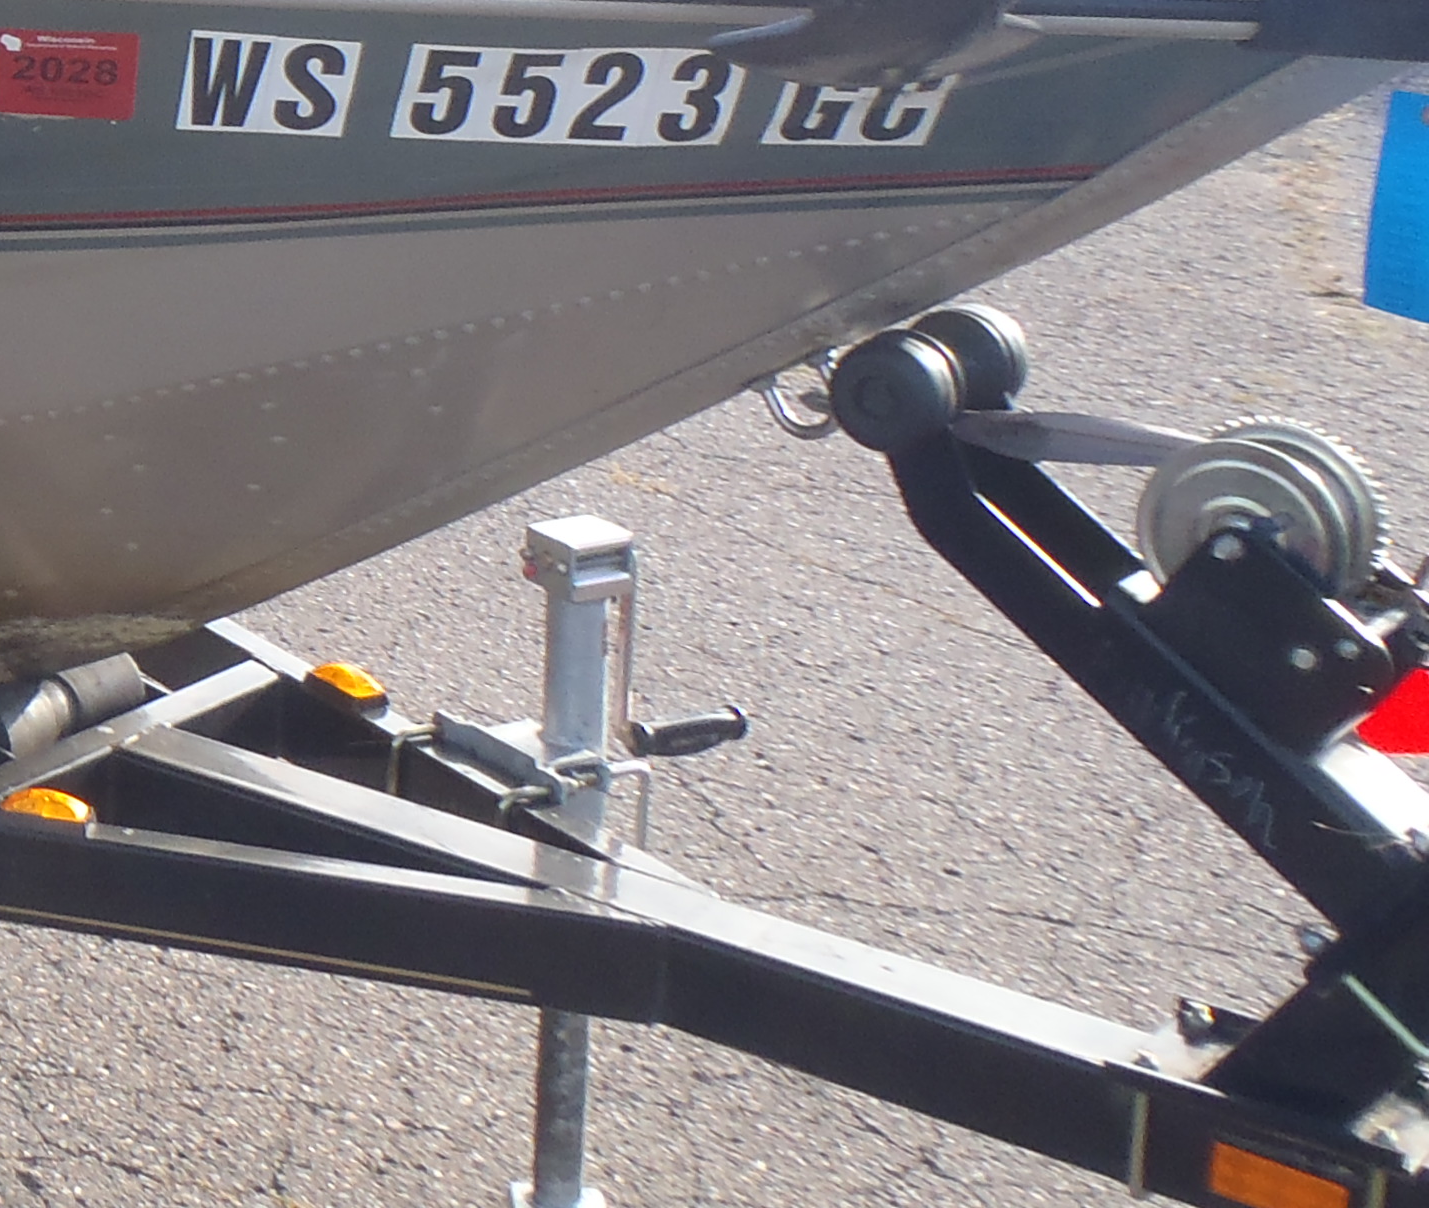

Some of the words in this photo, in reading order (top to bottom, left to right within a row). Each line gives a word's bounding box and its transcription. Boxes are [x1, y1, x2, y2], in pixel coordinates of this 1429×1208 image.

[12, 55, 118, 86] 2028
[190, 36, 346, 130] WS
[409, 49, 731, 142] 5523
